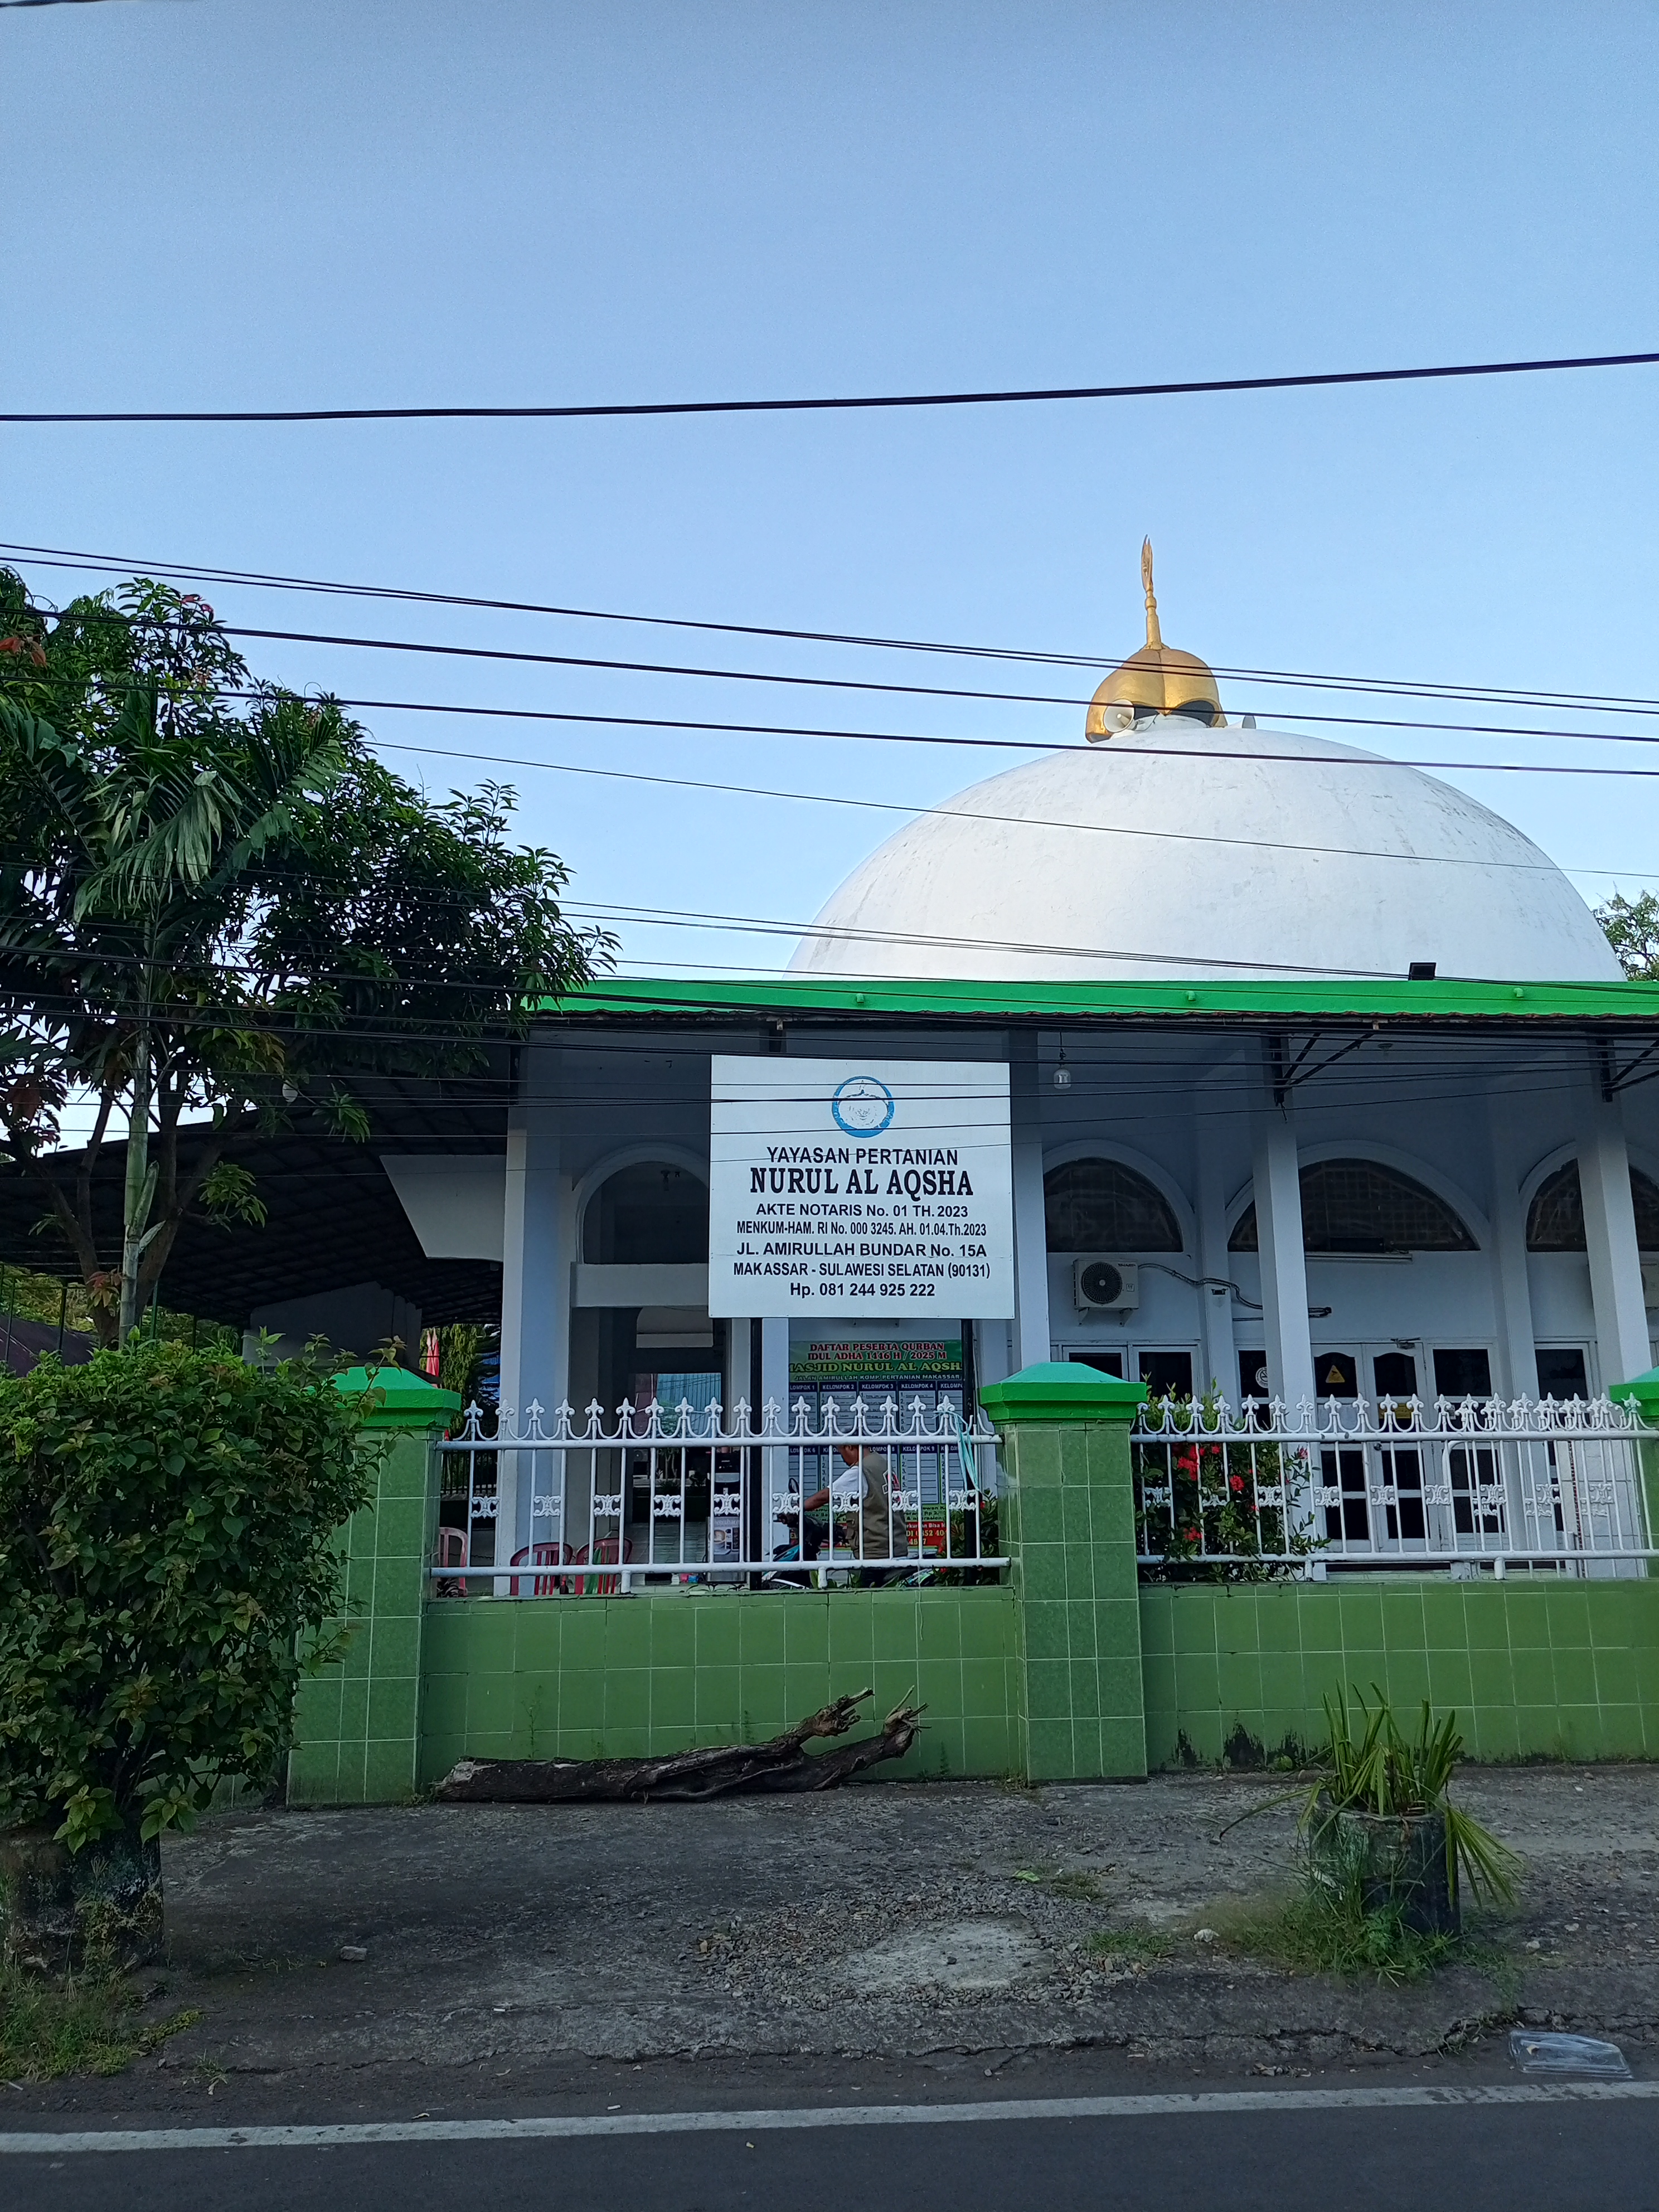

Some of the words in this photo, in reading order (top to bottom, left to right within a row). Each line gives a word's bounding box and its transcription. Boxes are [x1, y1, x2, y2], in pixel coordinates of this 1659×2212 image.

[767, 1146, 849, 1164] YAYASAN
[856, 1148, 958, 1166] PERTANIAN
[750, 1167, 839, 1194] NURUL
[846, 1169, 879, 1194] AL
[886, 1169, 973, 1202] AQSHA
[756, 1203, 795, 1215] AKTE
[799, 1204, 862, 1216] NOTARIS
[866, 1204, 889, 1216] No.
[893, 1205, 907, 1217] 01
[912, 1205, 935, 1217] TH.
[937, 1205, 968, 1217] 2023
[737, 1220, 814, 1234] MENKUM-HAM.
[817, 1221, 828, 1234] RI
[831, 1221, 847, 1234] No.
[850, 1222, 868, 1235] 000
[871, 1222, 896, 1235] 3245.
[899, 1222, 916, 1235] AH.
[919, 1223, 987, 1236] 01.04.Th.2023
[736, 1242, 759, 1255] JL.
[763, 1242, 855, 1255] AMIRULLAH
[860, 1243, 926, 1257] BUNDAR
[931, 1244, 954, 1257] No.
[959, 1244, 987, 1257] 15A
[734, 1262, 808, 1276] MAKASSAR
[819, 1263, 884, 1276] SULAWESI
[887, 1263, 944, 1277] SELATAN
[948, 1262, 990, 1279] (90131)
[790, 1282, 814, 1299] Hp.
[819, 1283, 843, 1296] 081
[850, 1283, 876, 1296] 244
[880, 1283, 905, 1297] 925
[909, 1283, 935, 1297] 222
[810, 1343, 850, 1351] DAFTAR
[853, 1342, 899, 1351] PESERTA
[901, 1342, 944, 1351] QURBAN
[834, 1352, 864, 1360] ADHA
[866, 1351, 891, 1360] 1446
[892, 1351, 902, 1360] H
[903, 1351, 908, 1360] /
[910, 1351, 935, 1360] 2025
[937, 1351, 947, 1360] M
[842, 1362, 894, 1371] NURUL
[897, 1362, 917, 1371] AL
[920, 1362, 962, 1372] AQSH
